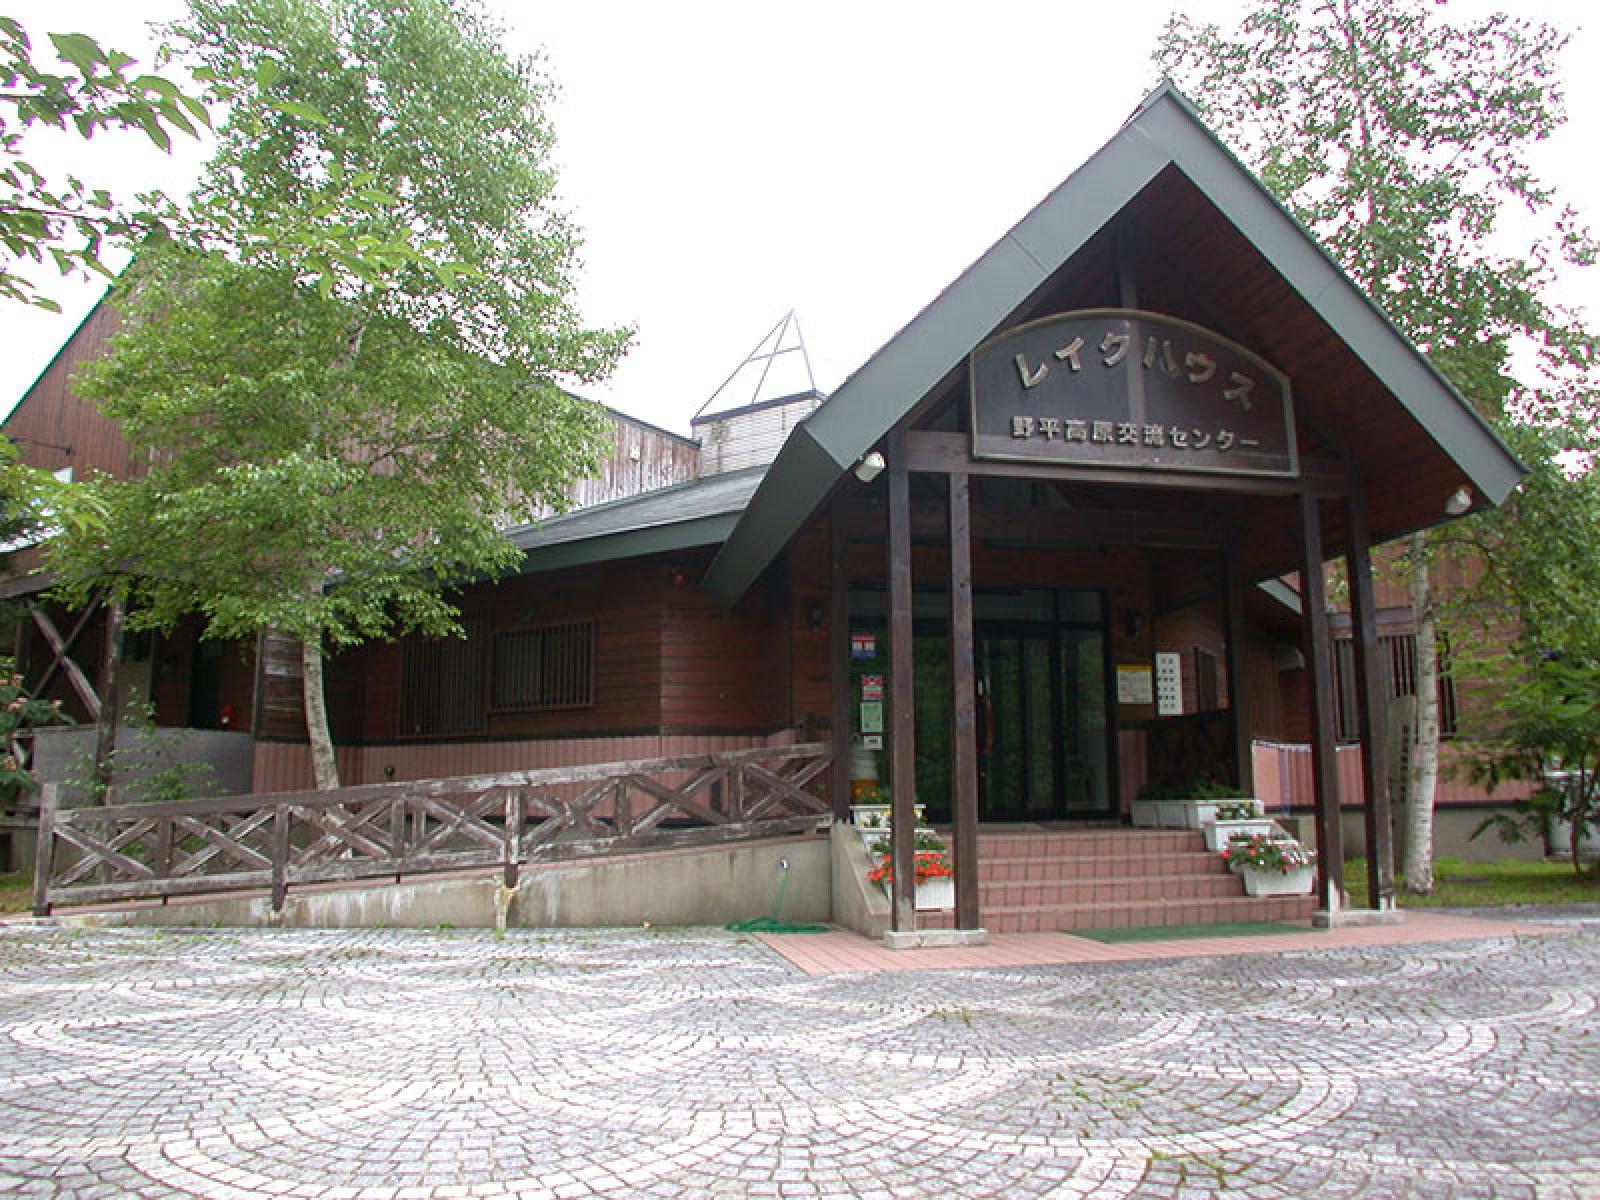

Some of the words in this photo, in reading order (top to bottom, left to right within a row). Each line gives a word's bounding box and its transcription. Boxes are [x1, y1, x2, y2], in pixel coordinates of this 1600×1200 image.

[1014, 331, 1256, 411] レイクハウス
[1011, 415, 1259, 449] 野平高原交流センター
